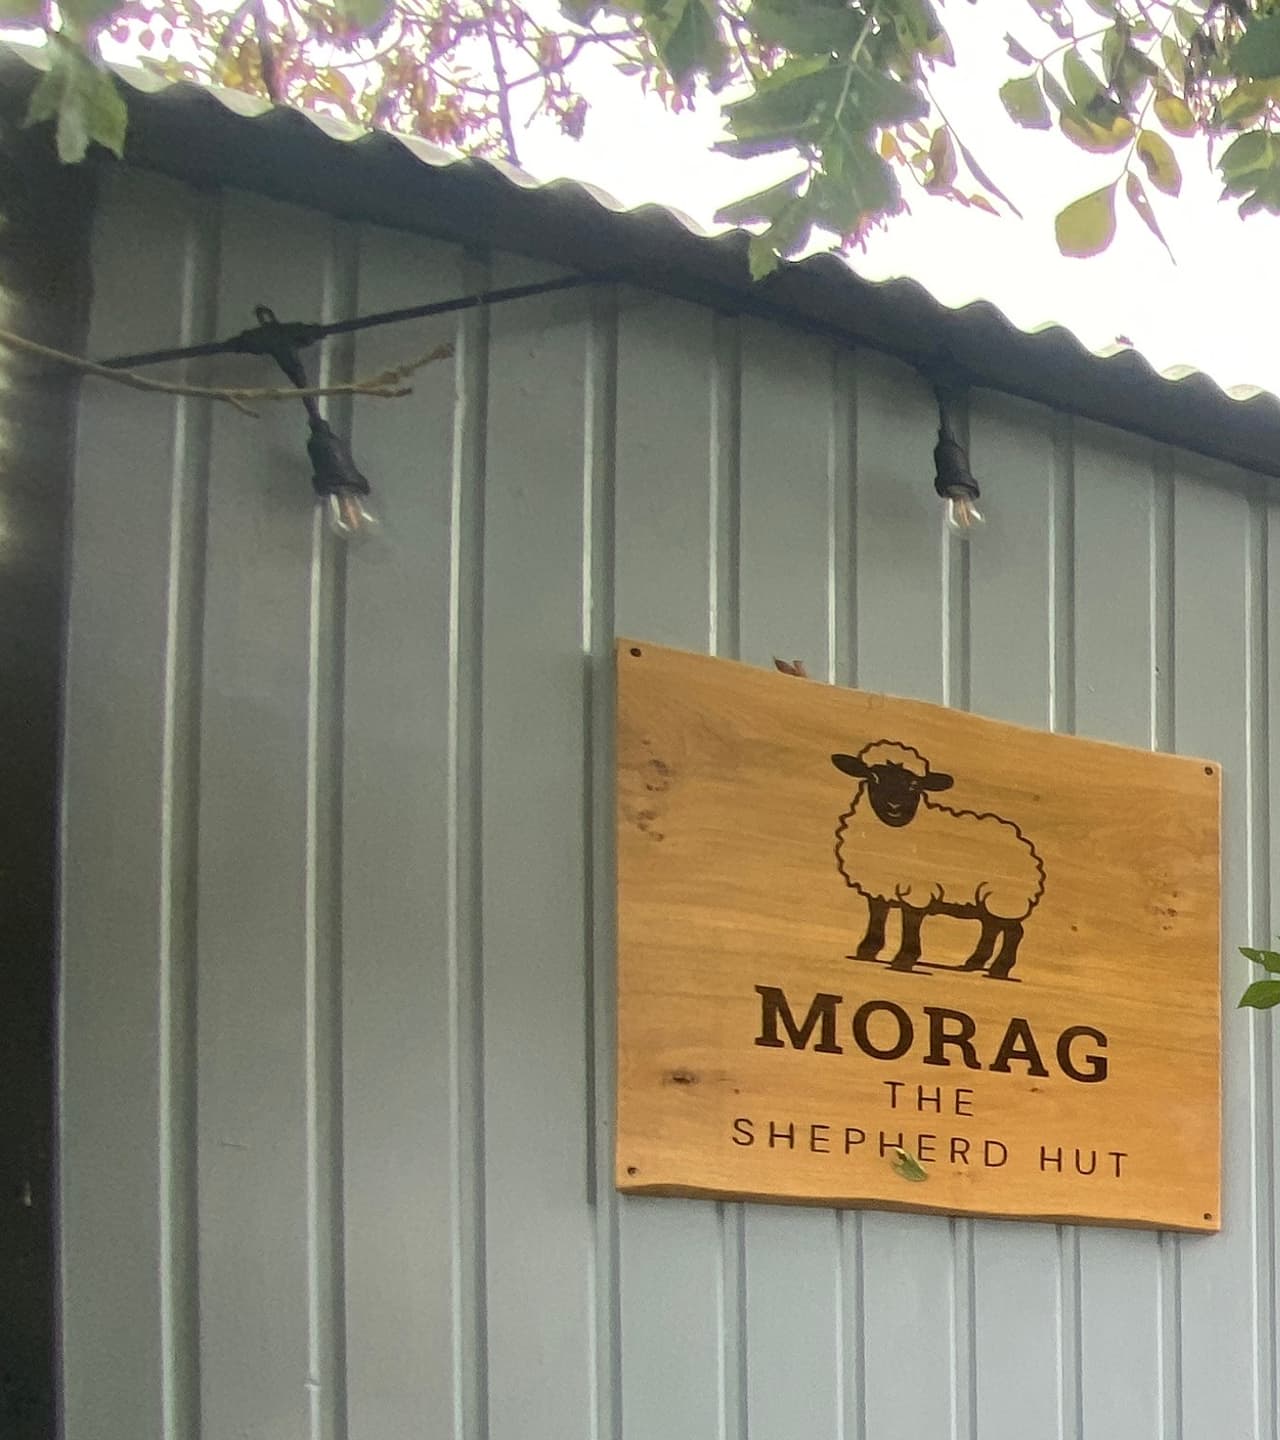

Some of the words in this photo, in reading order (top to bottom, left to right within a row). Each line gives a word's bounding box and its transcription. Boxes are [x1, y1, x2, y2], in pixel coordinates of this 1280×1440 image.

[754, 985, 1108, 1084] MORAG
[883, 1081, 974, 1116] THE
[732, 1117, 1008, 1168] SHEPHERD
[1040, 1146, 1129, 1178] HUT
